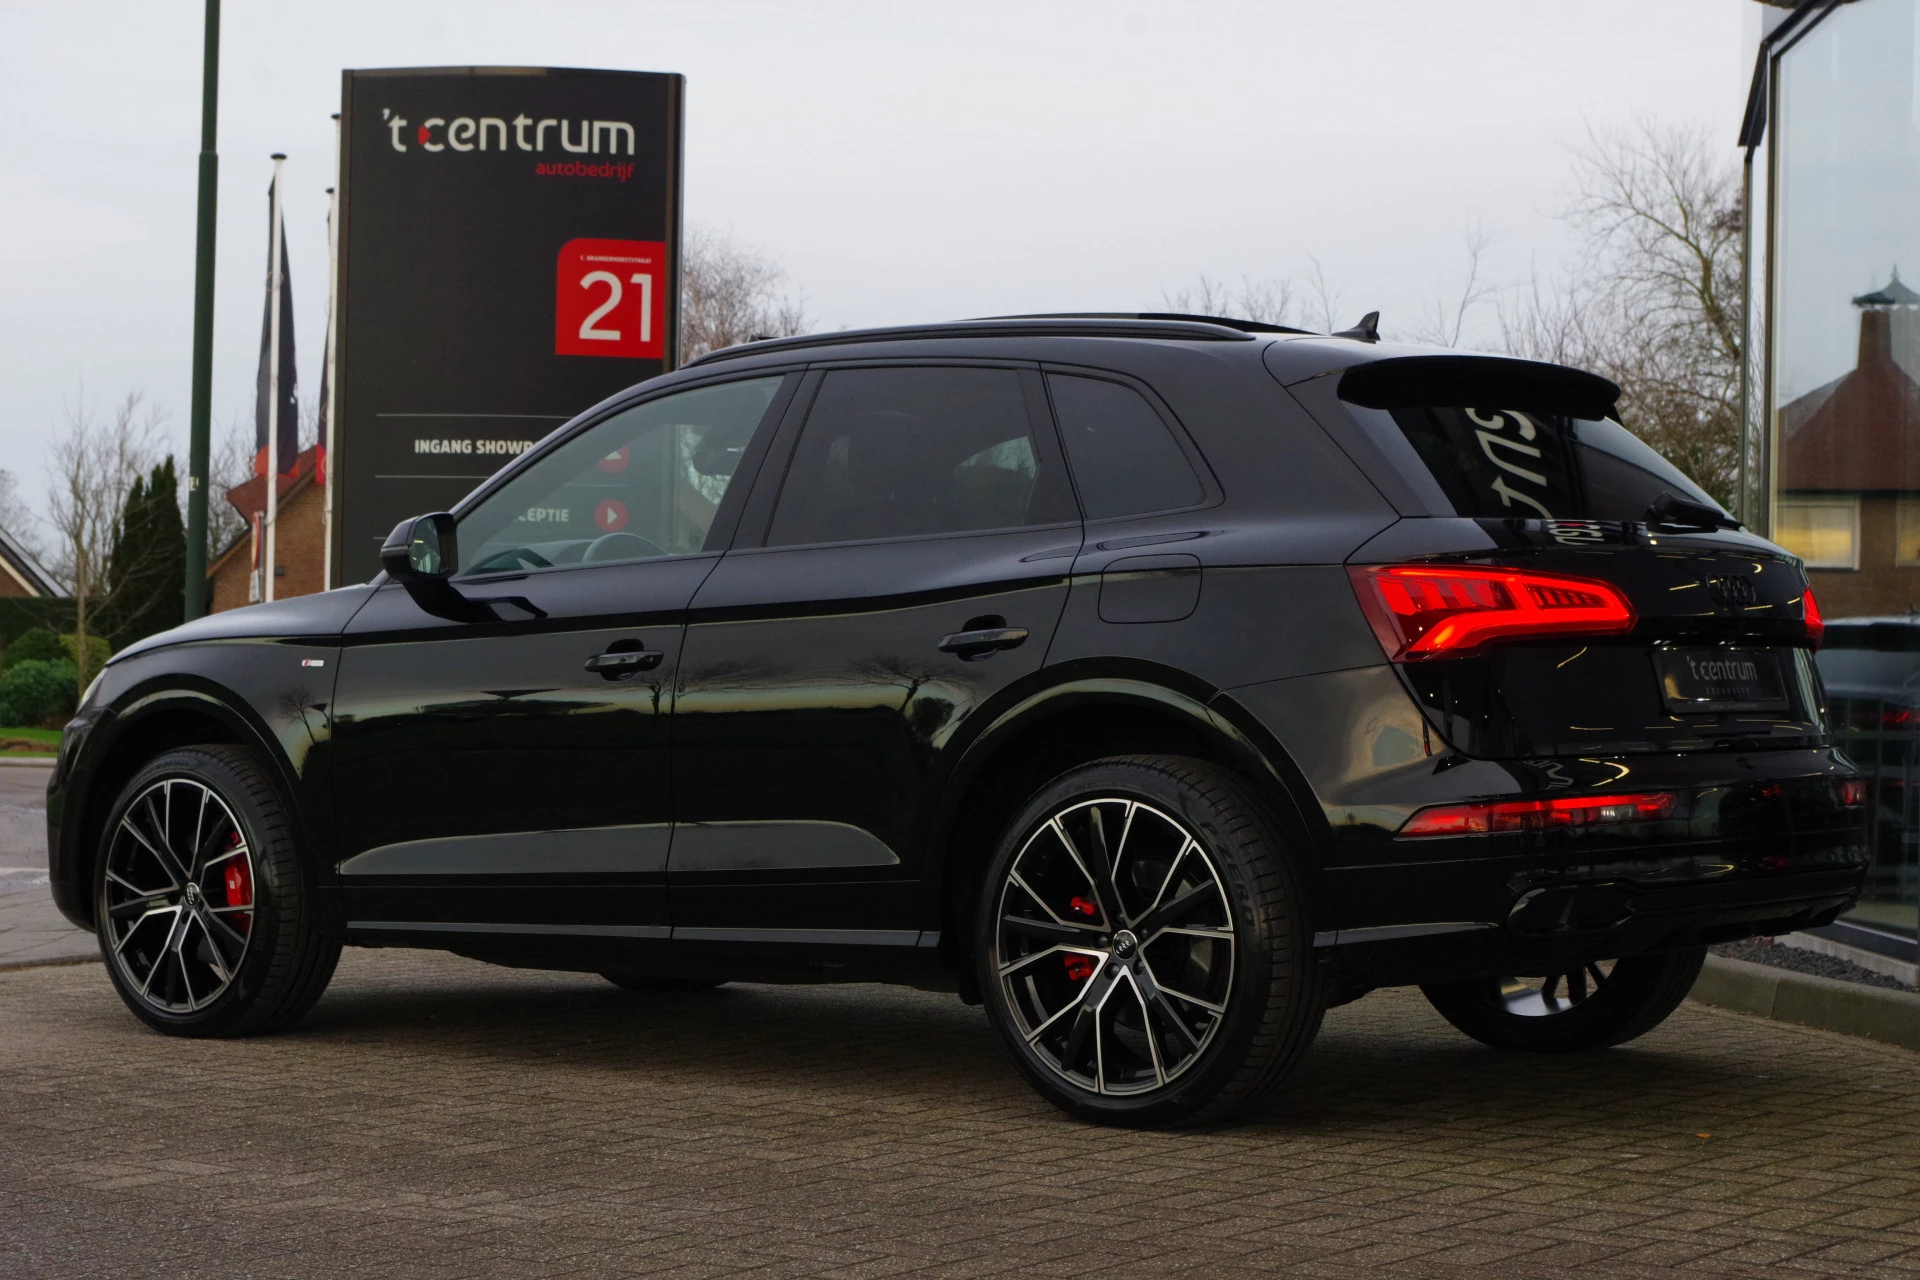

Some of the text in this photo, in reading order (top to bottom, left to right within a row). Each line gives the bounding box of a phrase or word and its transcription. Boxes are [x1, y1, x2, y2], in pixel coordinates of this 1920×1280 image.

[382, 108, 635, 155] 't centrum
[536, 161, 634, 182] autobedrijf
[579, 271, 652, 342] 21
[414, 439, 535, 454] INGANG SHOWR
[1700, 659, 1758, 680] centrum
